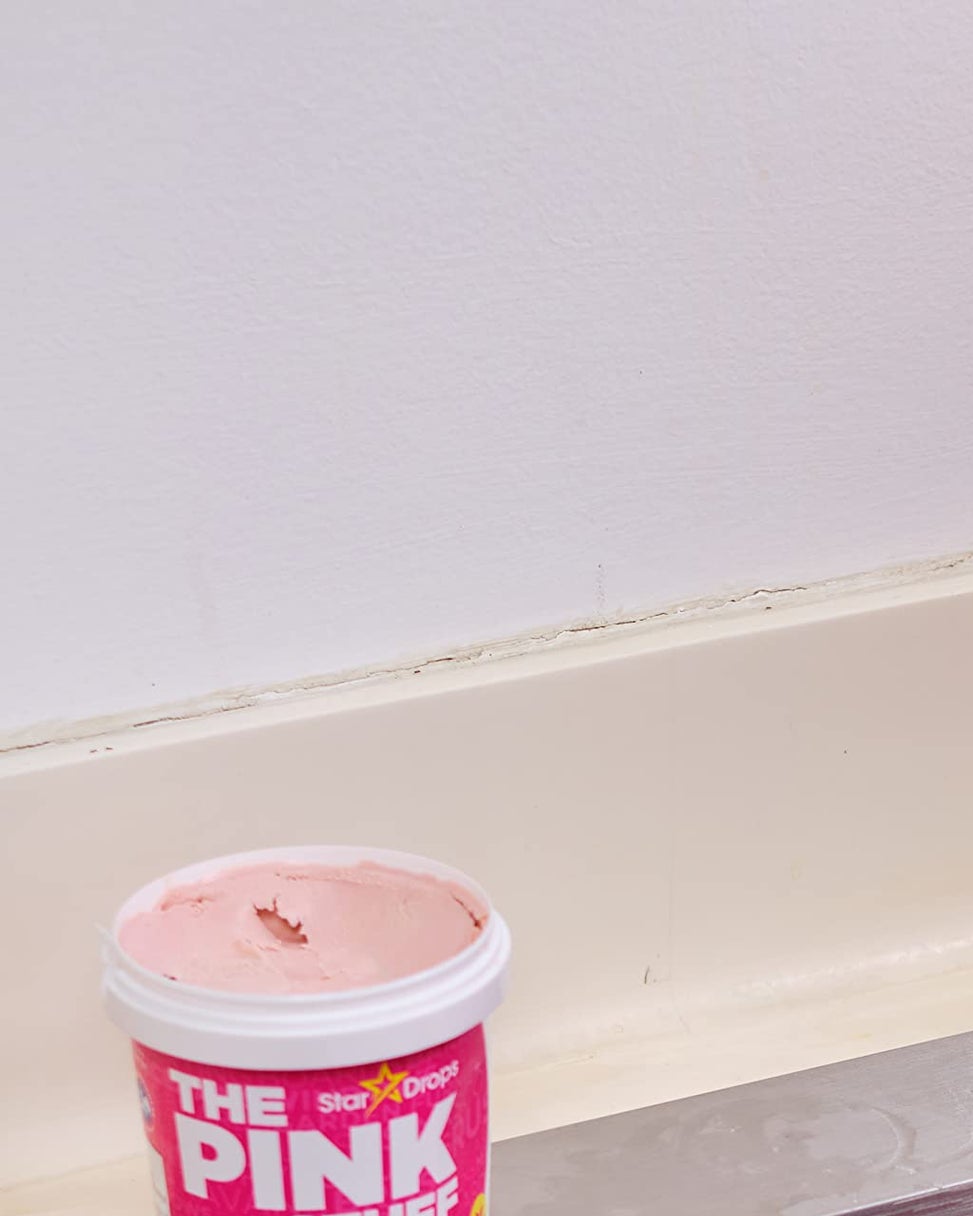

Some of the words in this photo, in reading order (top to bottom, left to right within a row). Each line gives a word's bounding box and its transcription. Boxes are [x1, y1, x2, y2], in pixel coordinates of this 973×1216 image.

[168, 1067, 289, 1128] THE
[318, 1091, 370, 1114] Star
[402, 1060, 460, 1099] Drops
[173, 1091, 458, 1212] PINK
